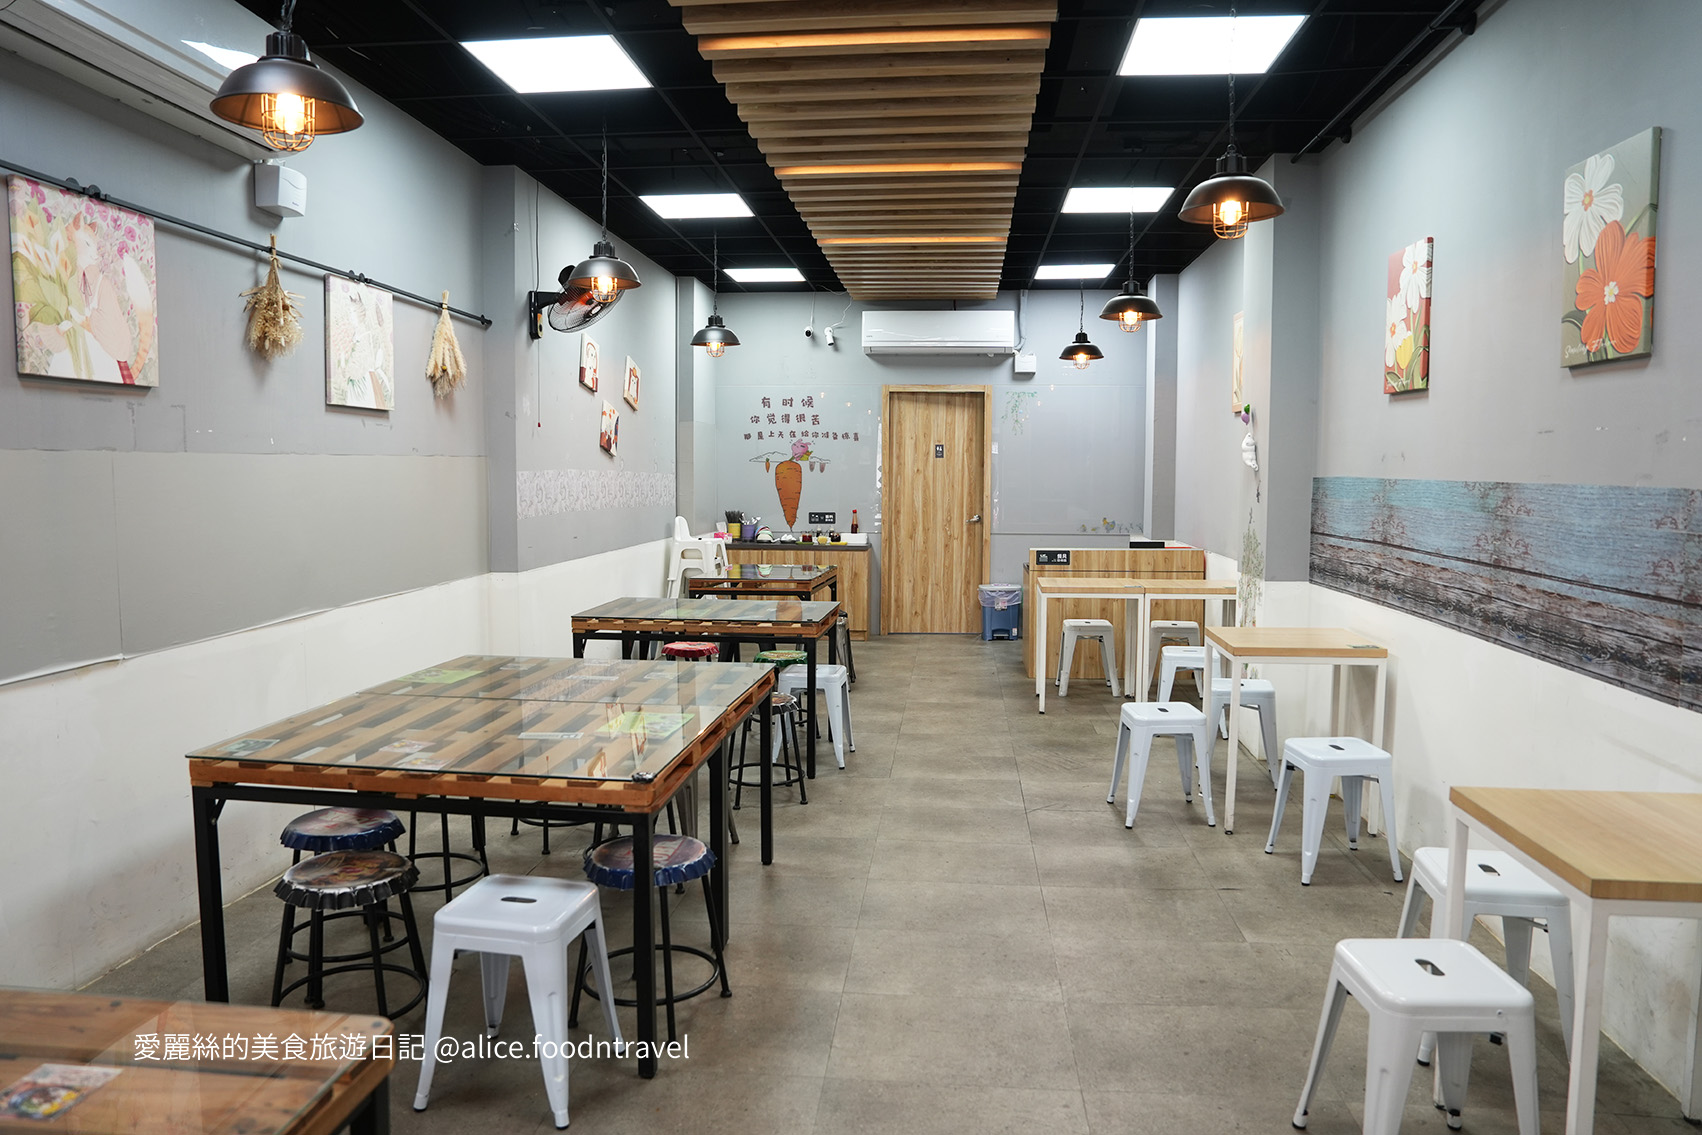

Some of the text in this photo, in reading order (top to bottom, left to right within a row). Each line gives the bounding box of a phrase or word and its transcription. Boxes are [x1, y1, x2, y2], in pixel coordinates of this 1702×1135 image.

[761, 395, 815, 409] 有时候
[750, 412, 821, 426] 你觉得很苦
